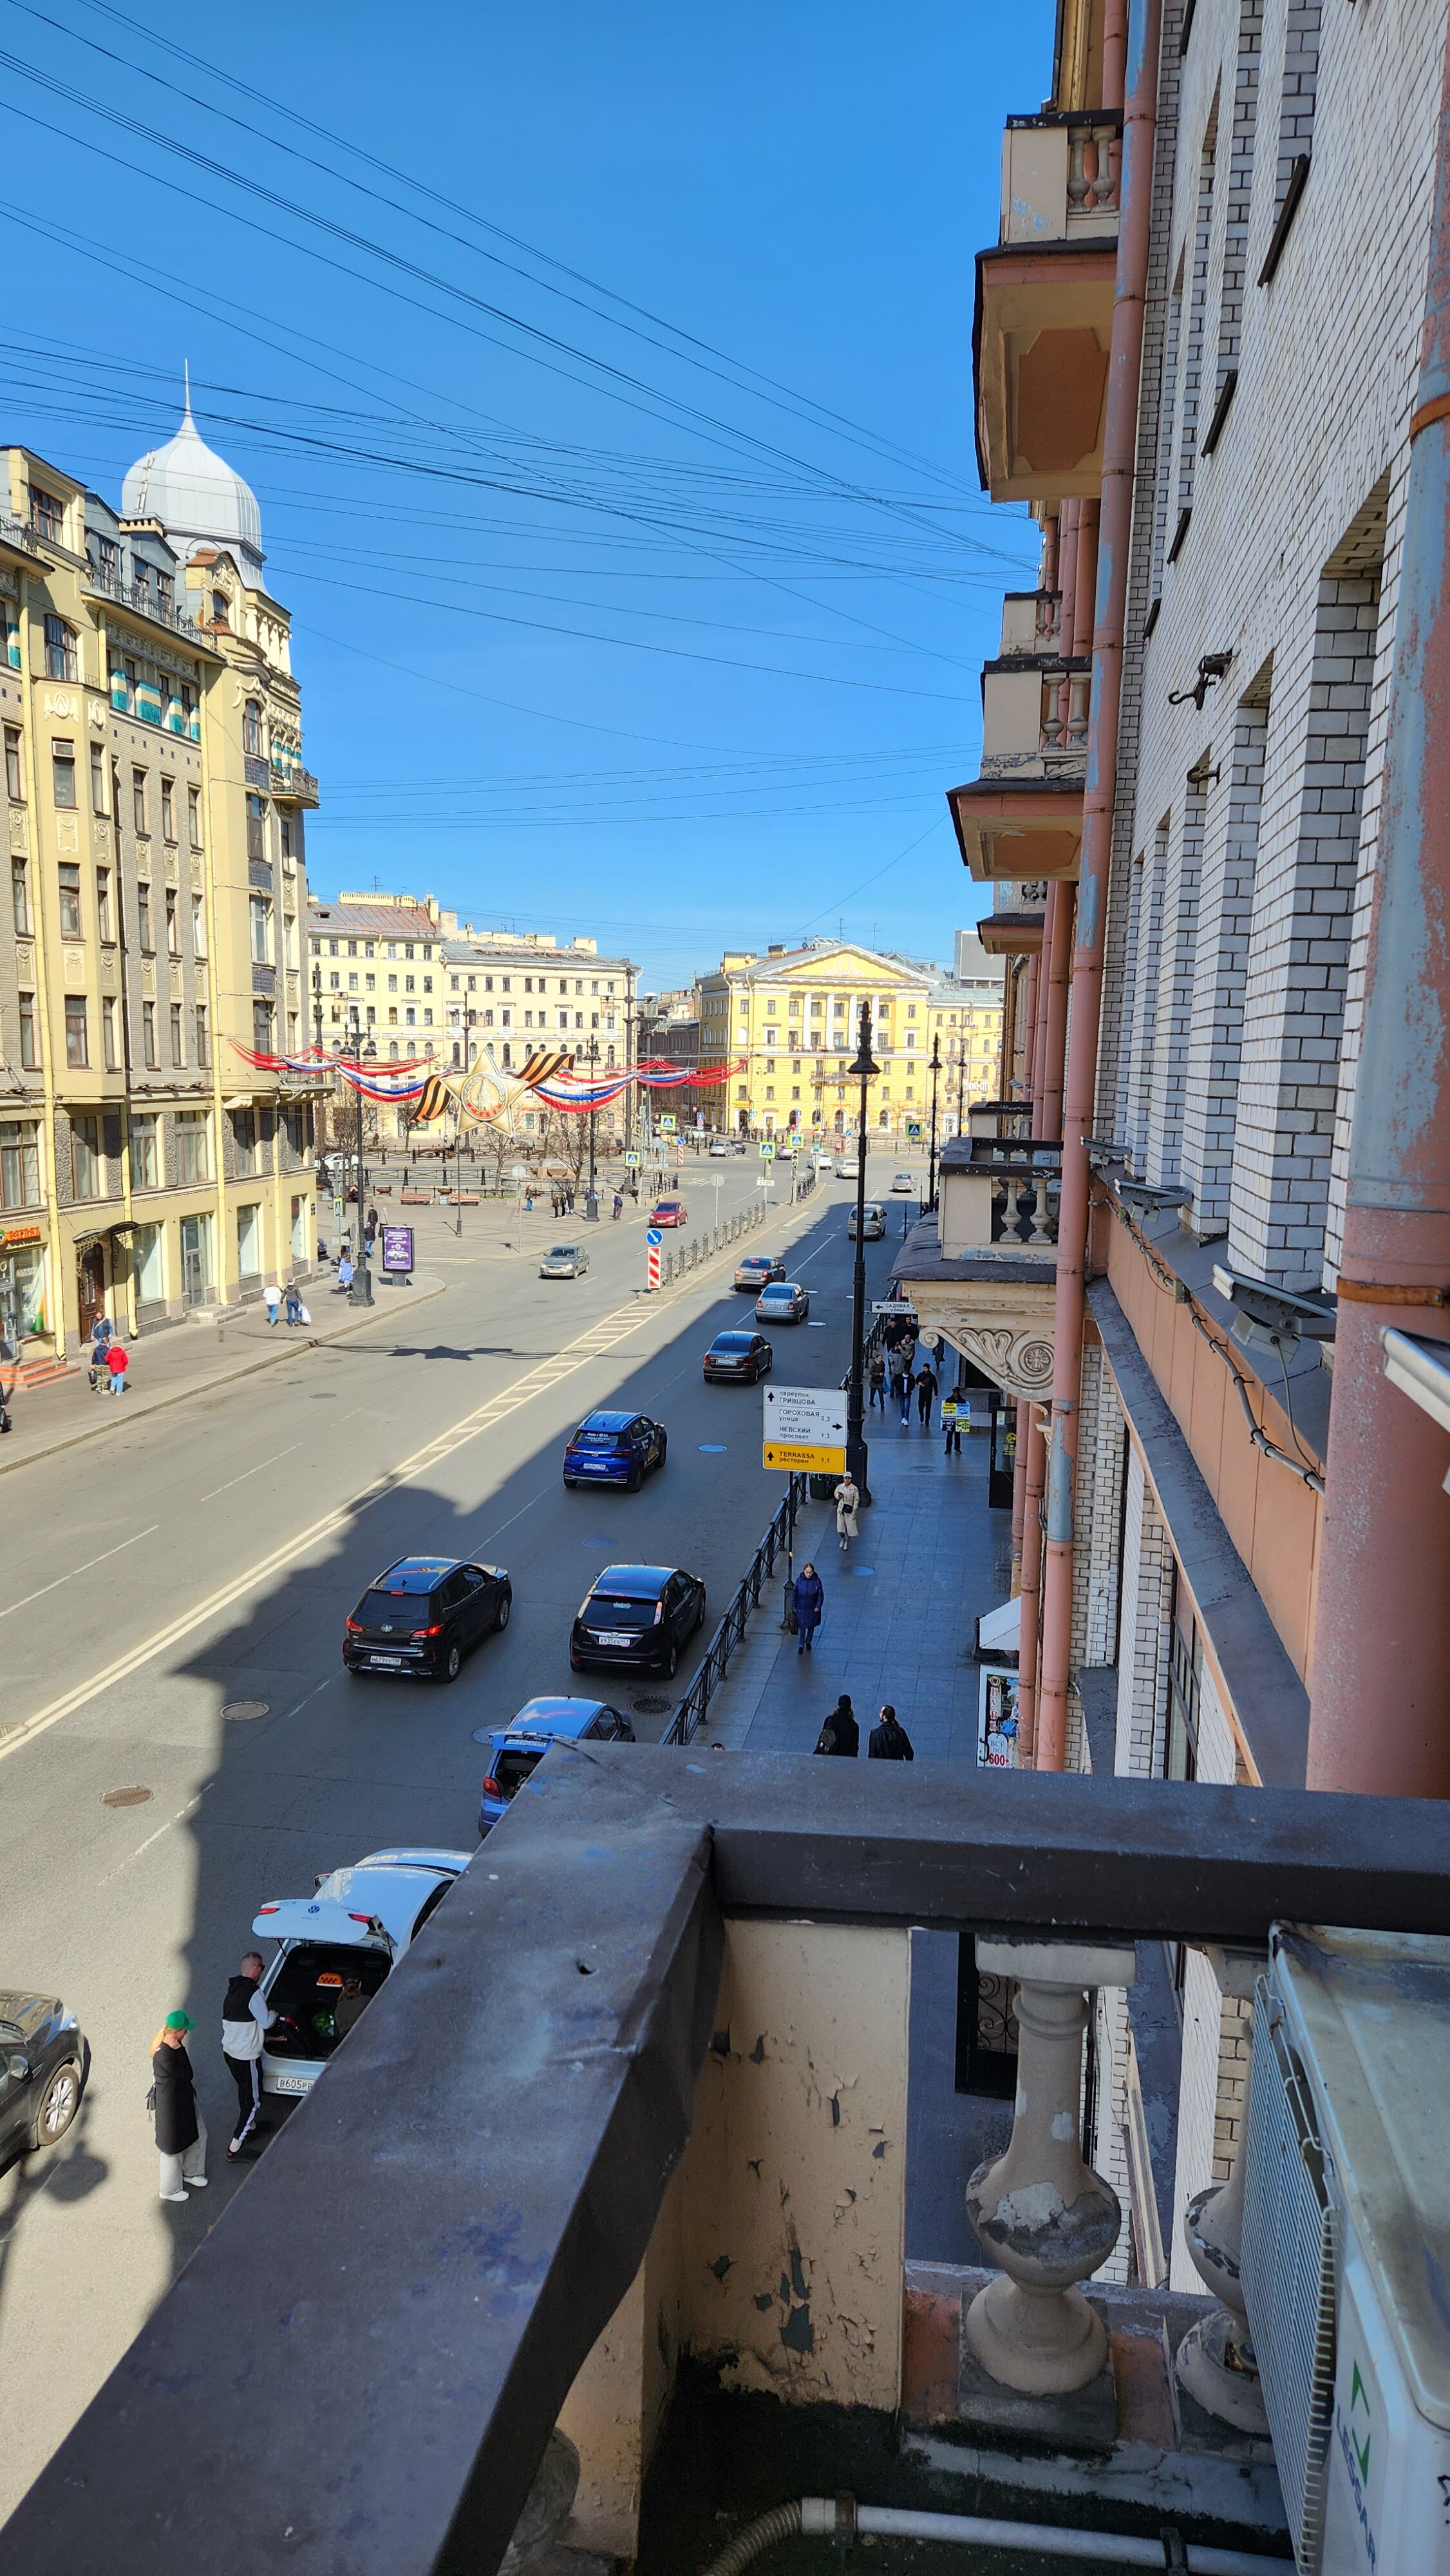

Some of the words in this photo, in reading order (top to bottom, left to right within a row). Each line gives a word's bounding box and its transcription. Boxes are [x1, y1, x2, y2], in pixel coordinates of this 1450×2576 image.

[780, 1391, 809, 1399] переулок
[989, 1676, 1001, 1732] ОБУВЬ
[1336, 2402, 1376, 2572] LESSAR
